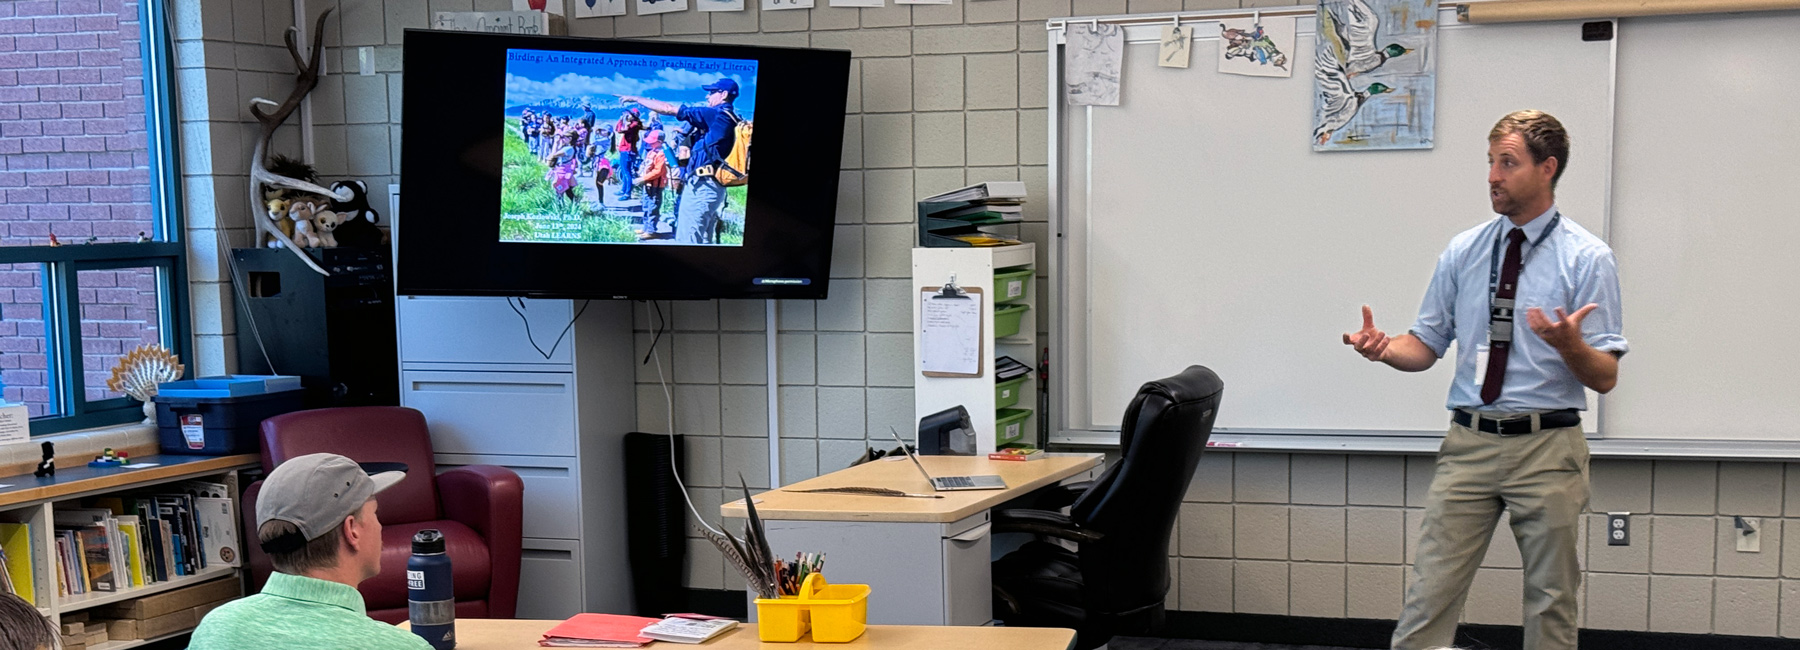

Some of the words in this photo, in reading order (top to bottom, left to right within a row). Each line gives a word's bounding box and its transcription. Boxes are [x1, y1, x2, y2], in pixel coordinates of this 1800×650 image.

[508, 52, 543, 63] Birding:
[546, 54, 559, 63] An
[561, 55, 604, 66] Integrated
[606, 57, 646, 68] Approach
[661, 59, 697, 70] Teaching
[699, 61, 720, 71] Early
[723, 61, 756, 73] Literacy
[503, 212, 525, 220] Joseph
[551, 231, 582, 239] LEARNS
